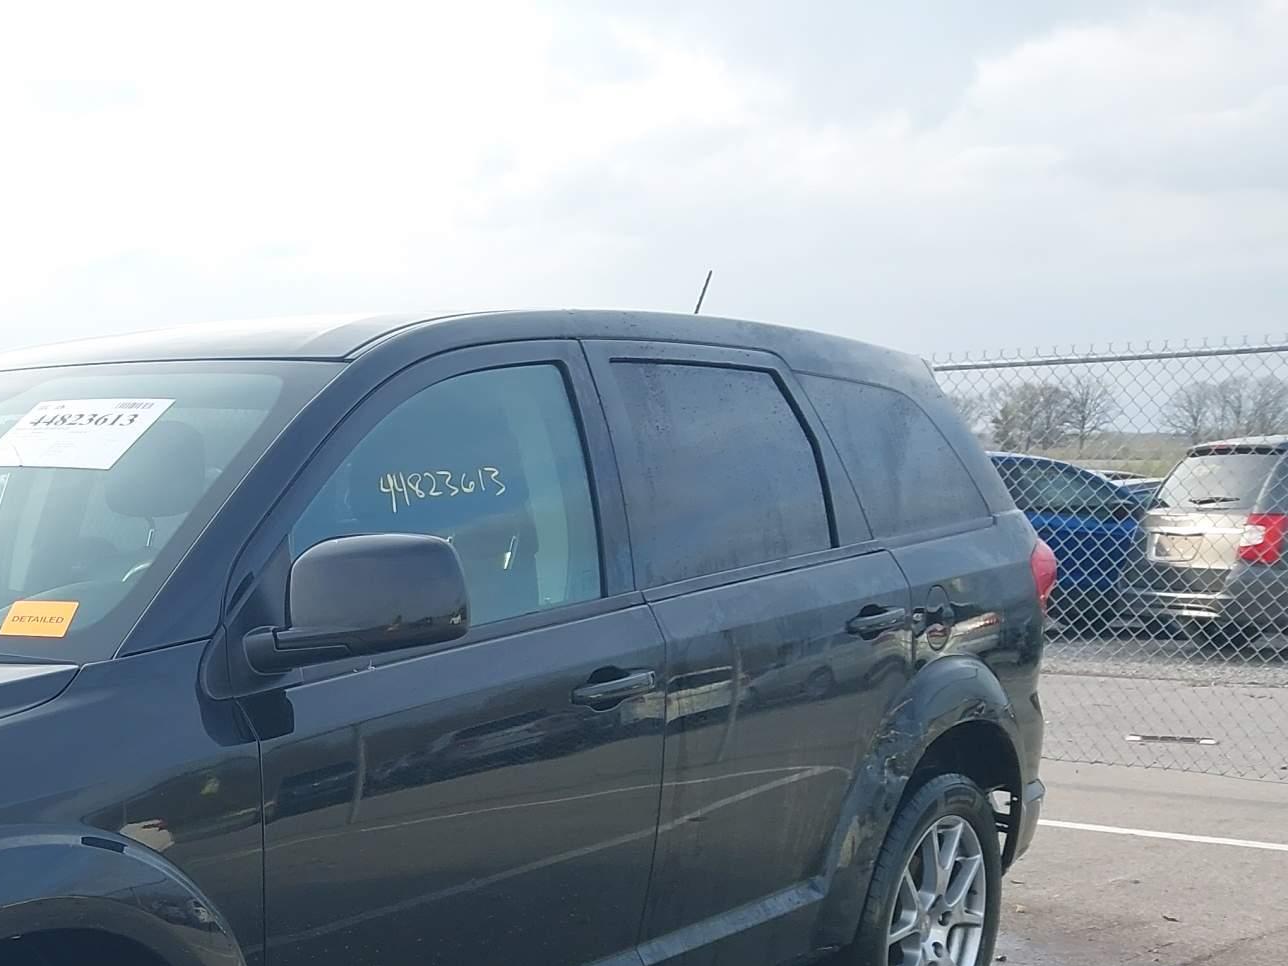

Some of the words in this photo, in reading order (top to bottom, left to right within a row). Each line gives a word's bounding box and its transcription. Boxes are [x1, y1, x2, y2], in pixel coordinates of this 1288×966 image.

[29, 413, 139, 427] 44823613
[379, 467, 506, 513] 44823613
[12, 615, 65, 624] DETAILED
